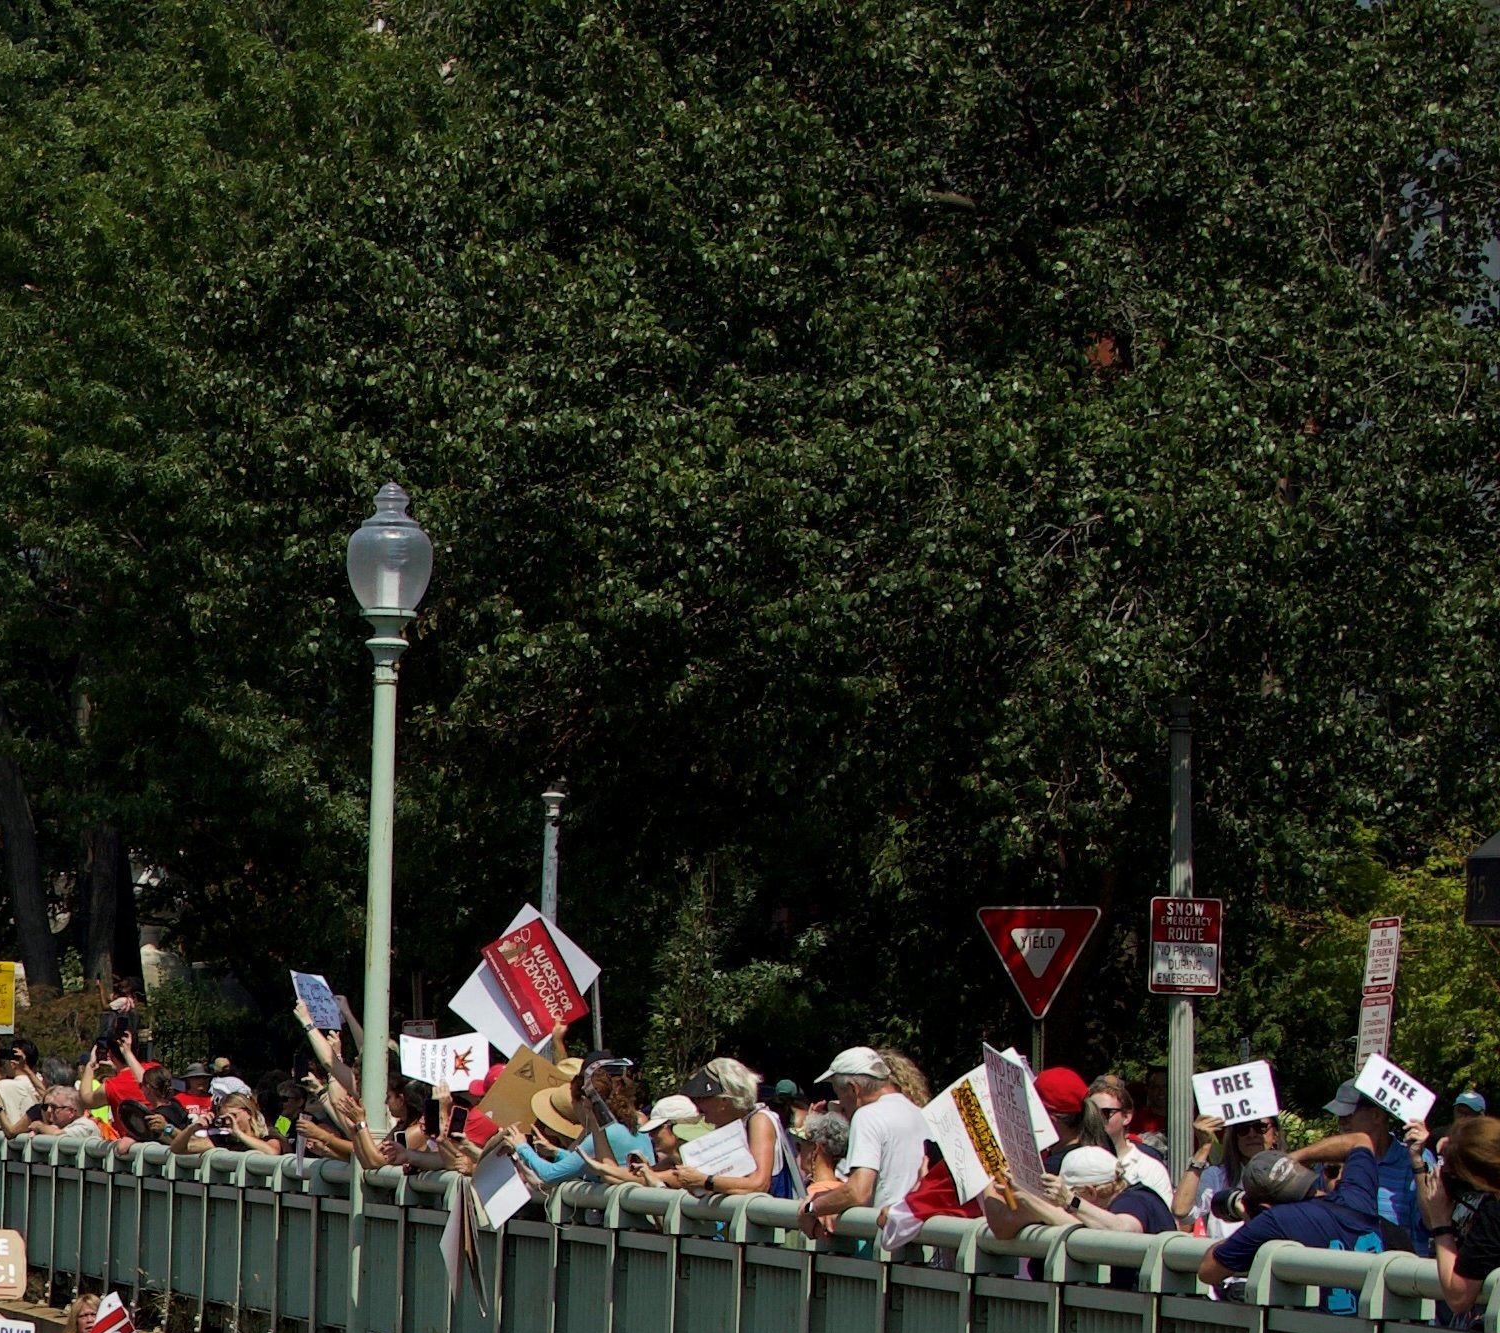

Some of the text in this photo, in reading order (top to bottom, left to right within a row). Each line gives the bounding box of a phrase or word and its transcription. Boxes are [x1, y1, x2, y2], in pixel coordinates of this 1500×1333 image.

[1166, 902, 1205, 916] SNOW
[1160, 916, 1212, 928] EMERGENCY
[1168, 927, 1205, 941] ROUTE
[1020, 935, 1056, 950] YIELD
[1157, 944, 1214, 958] NO PARKING
[1168, 959, 1203, 970] DURING
[532, 944, 573, 1012] NURSES FOR
[1157, 971, 1213, 986] EMERGENCY
[1211, 1070, 1254, 1095] FREE
[1223, 1099, 1257, 1121] D.C.
